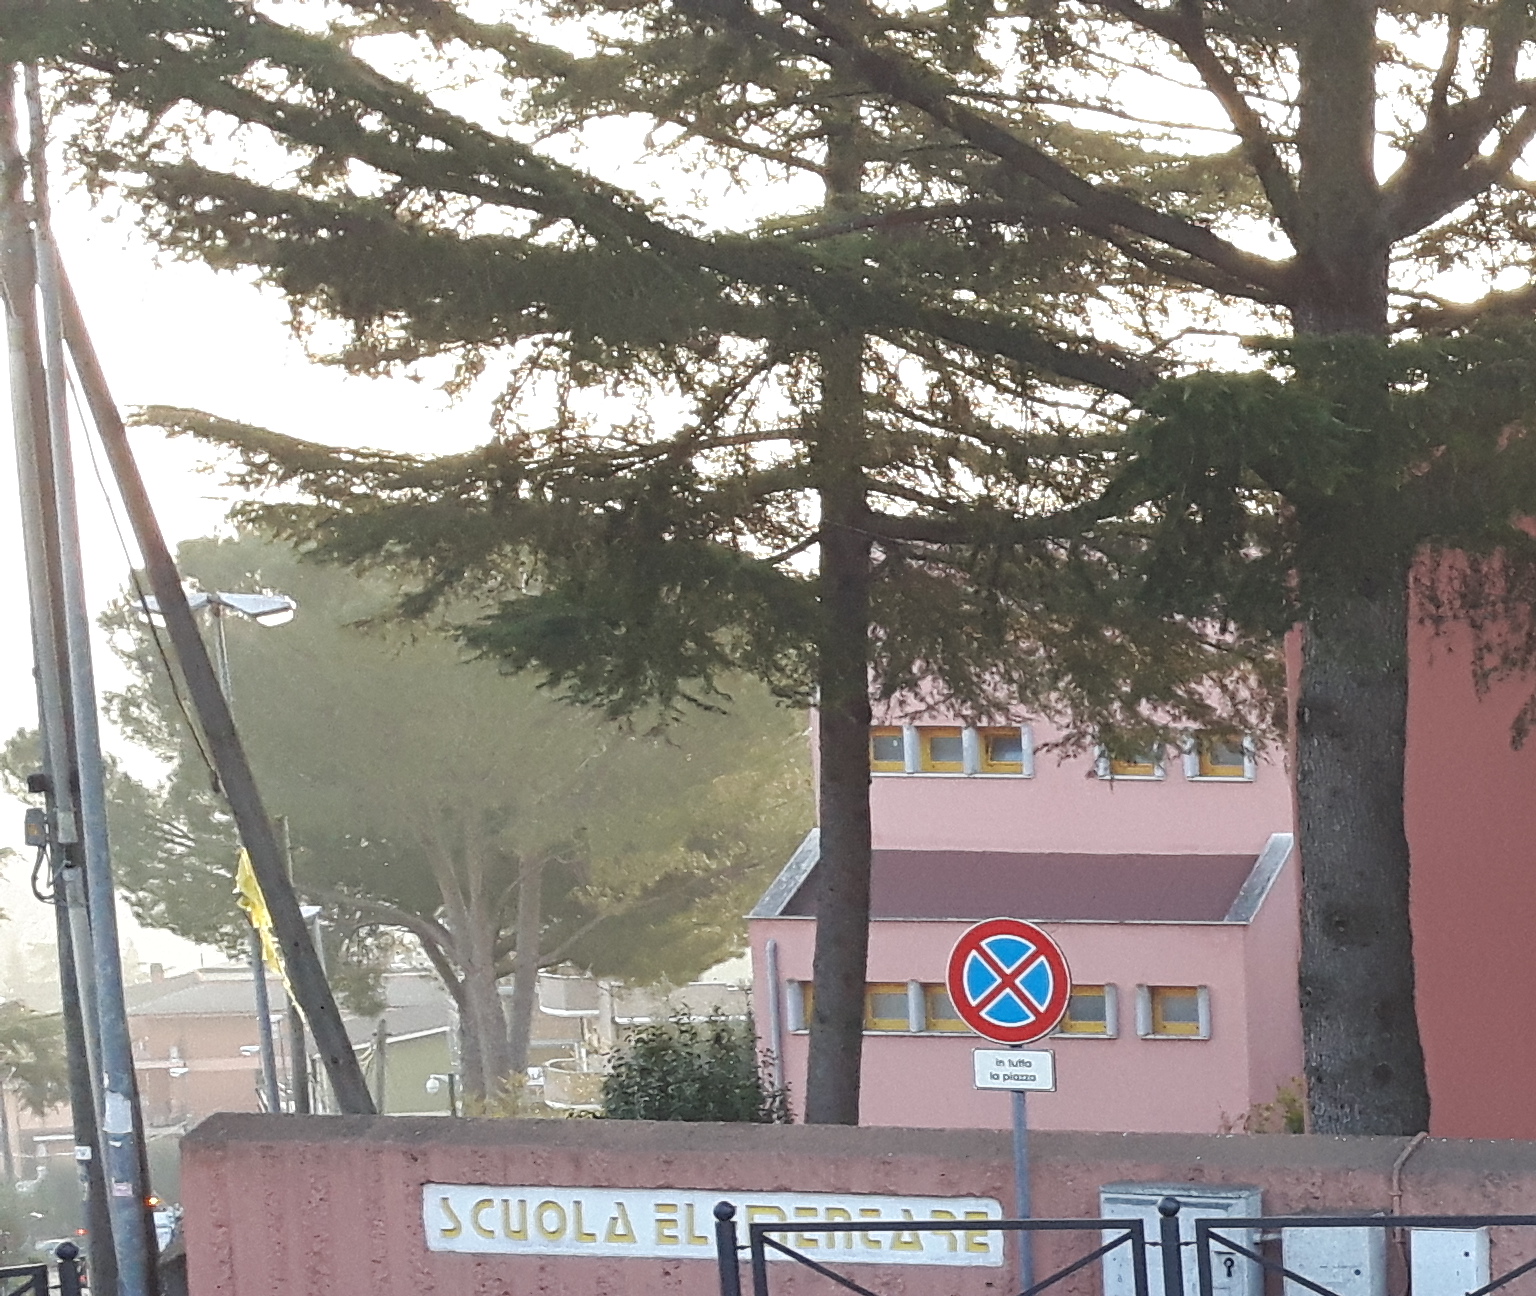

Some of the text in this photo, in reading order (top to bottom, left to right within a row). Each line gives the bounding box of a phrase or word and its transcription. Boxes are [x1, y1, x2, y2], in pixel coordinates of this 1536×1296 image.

[995, 1057, 1033, 1068] in tutta
[989, 1071, 1037, 1083] la piazza
[438, 1196, 992, 1254] SCUOLA ELMENTARE
